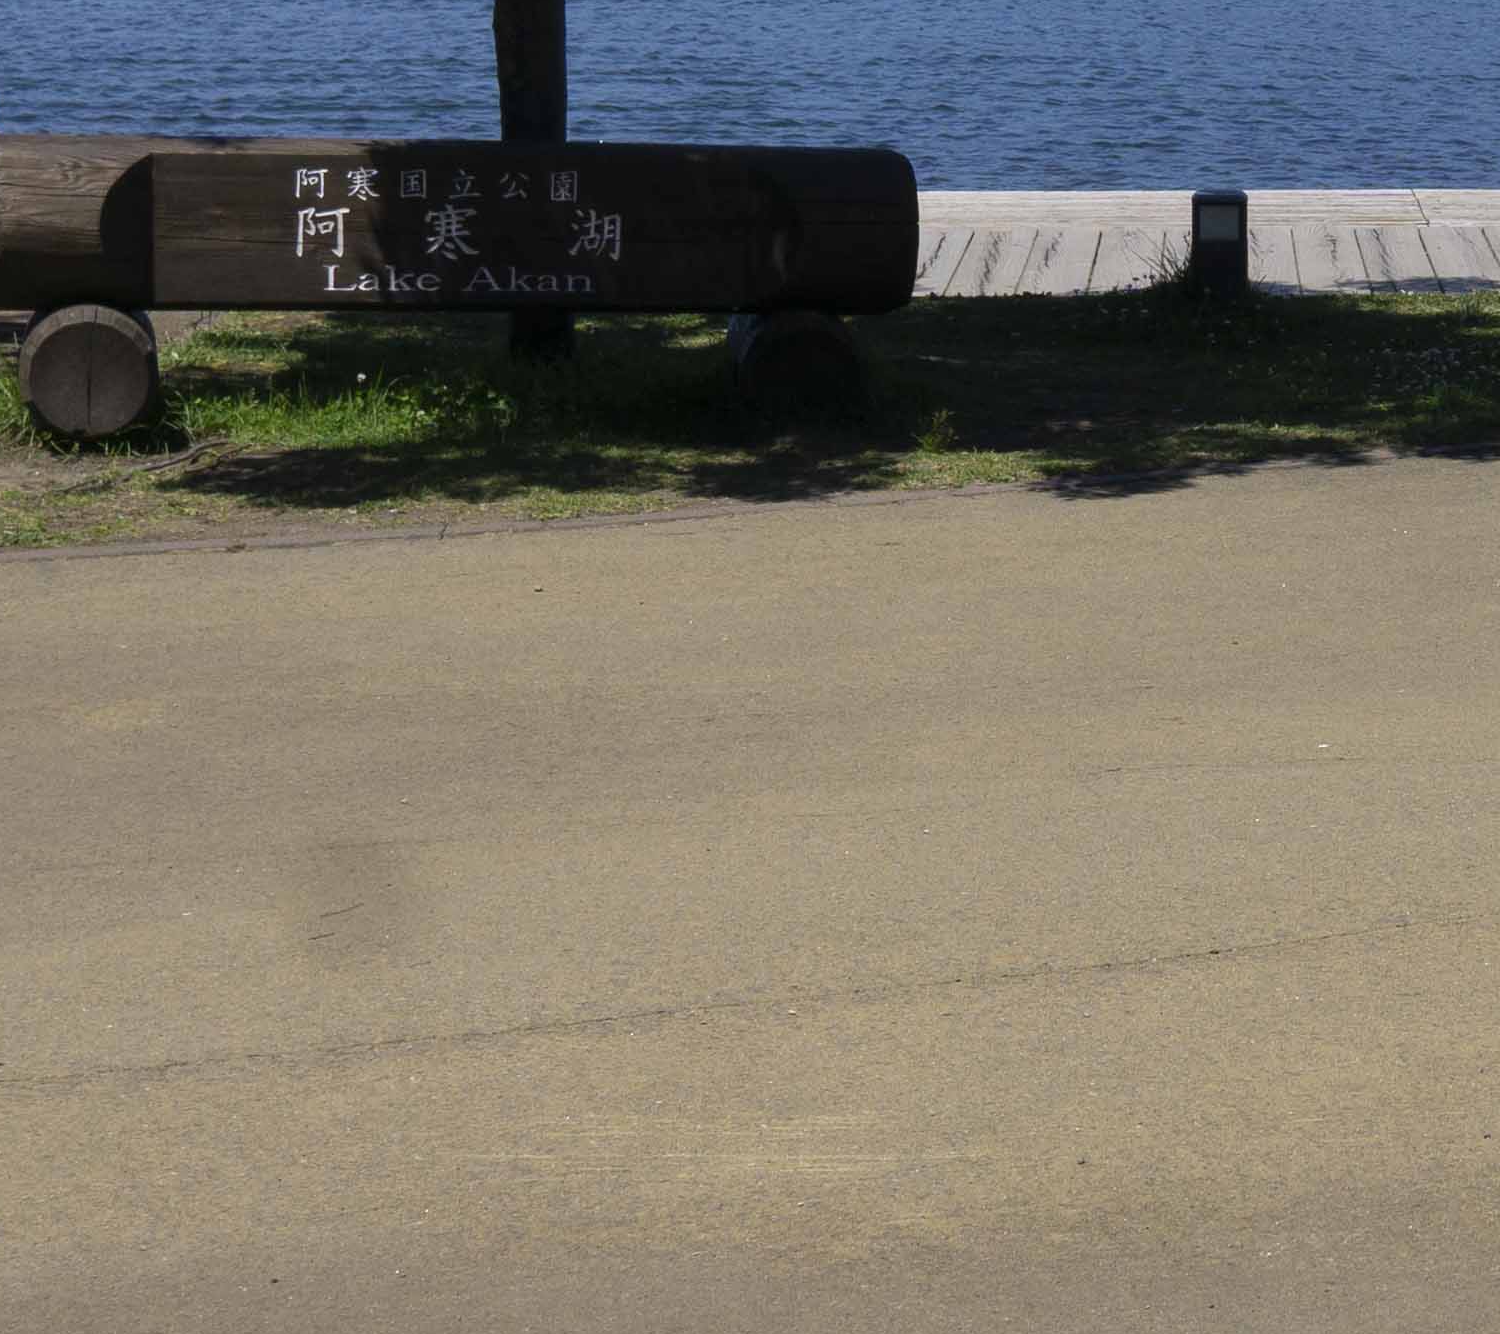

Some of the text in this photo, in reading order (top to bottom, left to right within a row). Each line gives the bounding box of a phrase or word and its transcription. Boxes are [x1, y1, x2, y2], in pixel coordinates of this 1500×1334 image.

[295, 167, 578, 202] 阿寒国立公園
[295, 203, 623, 261] 阿寒湖
[323, 264, 595, 293] Lake Akan
